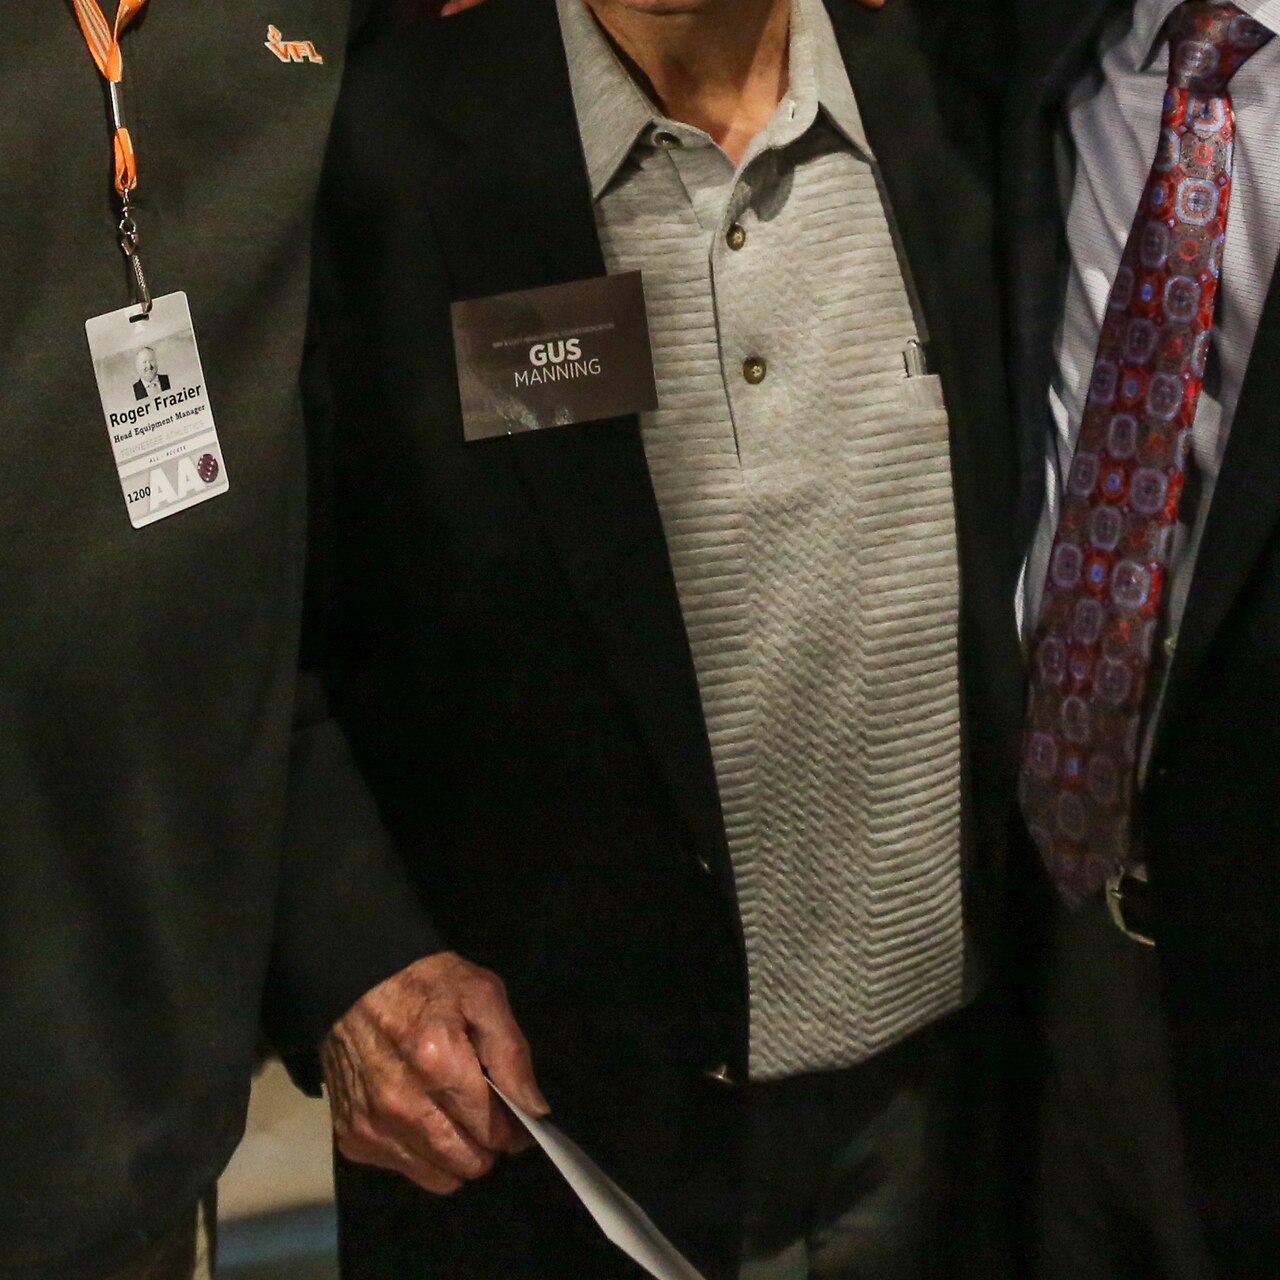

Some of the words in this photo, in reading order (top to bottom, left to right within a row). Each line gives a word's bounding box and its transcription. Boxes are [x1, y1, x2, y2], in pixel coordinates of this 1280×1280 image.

[529, 338, 582, 367] GUS
[514, 358, 601, 388] MANNING
[109, 403, 151, 427] Roger
[154, 385, 201, 410] Frazier
[113, 429, 133, 443] Head
[134, 416, 174, 436] Equipment
[175, 405, 205, 420] Manager
[127, 486, 151, 504] 1200
